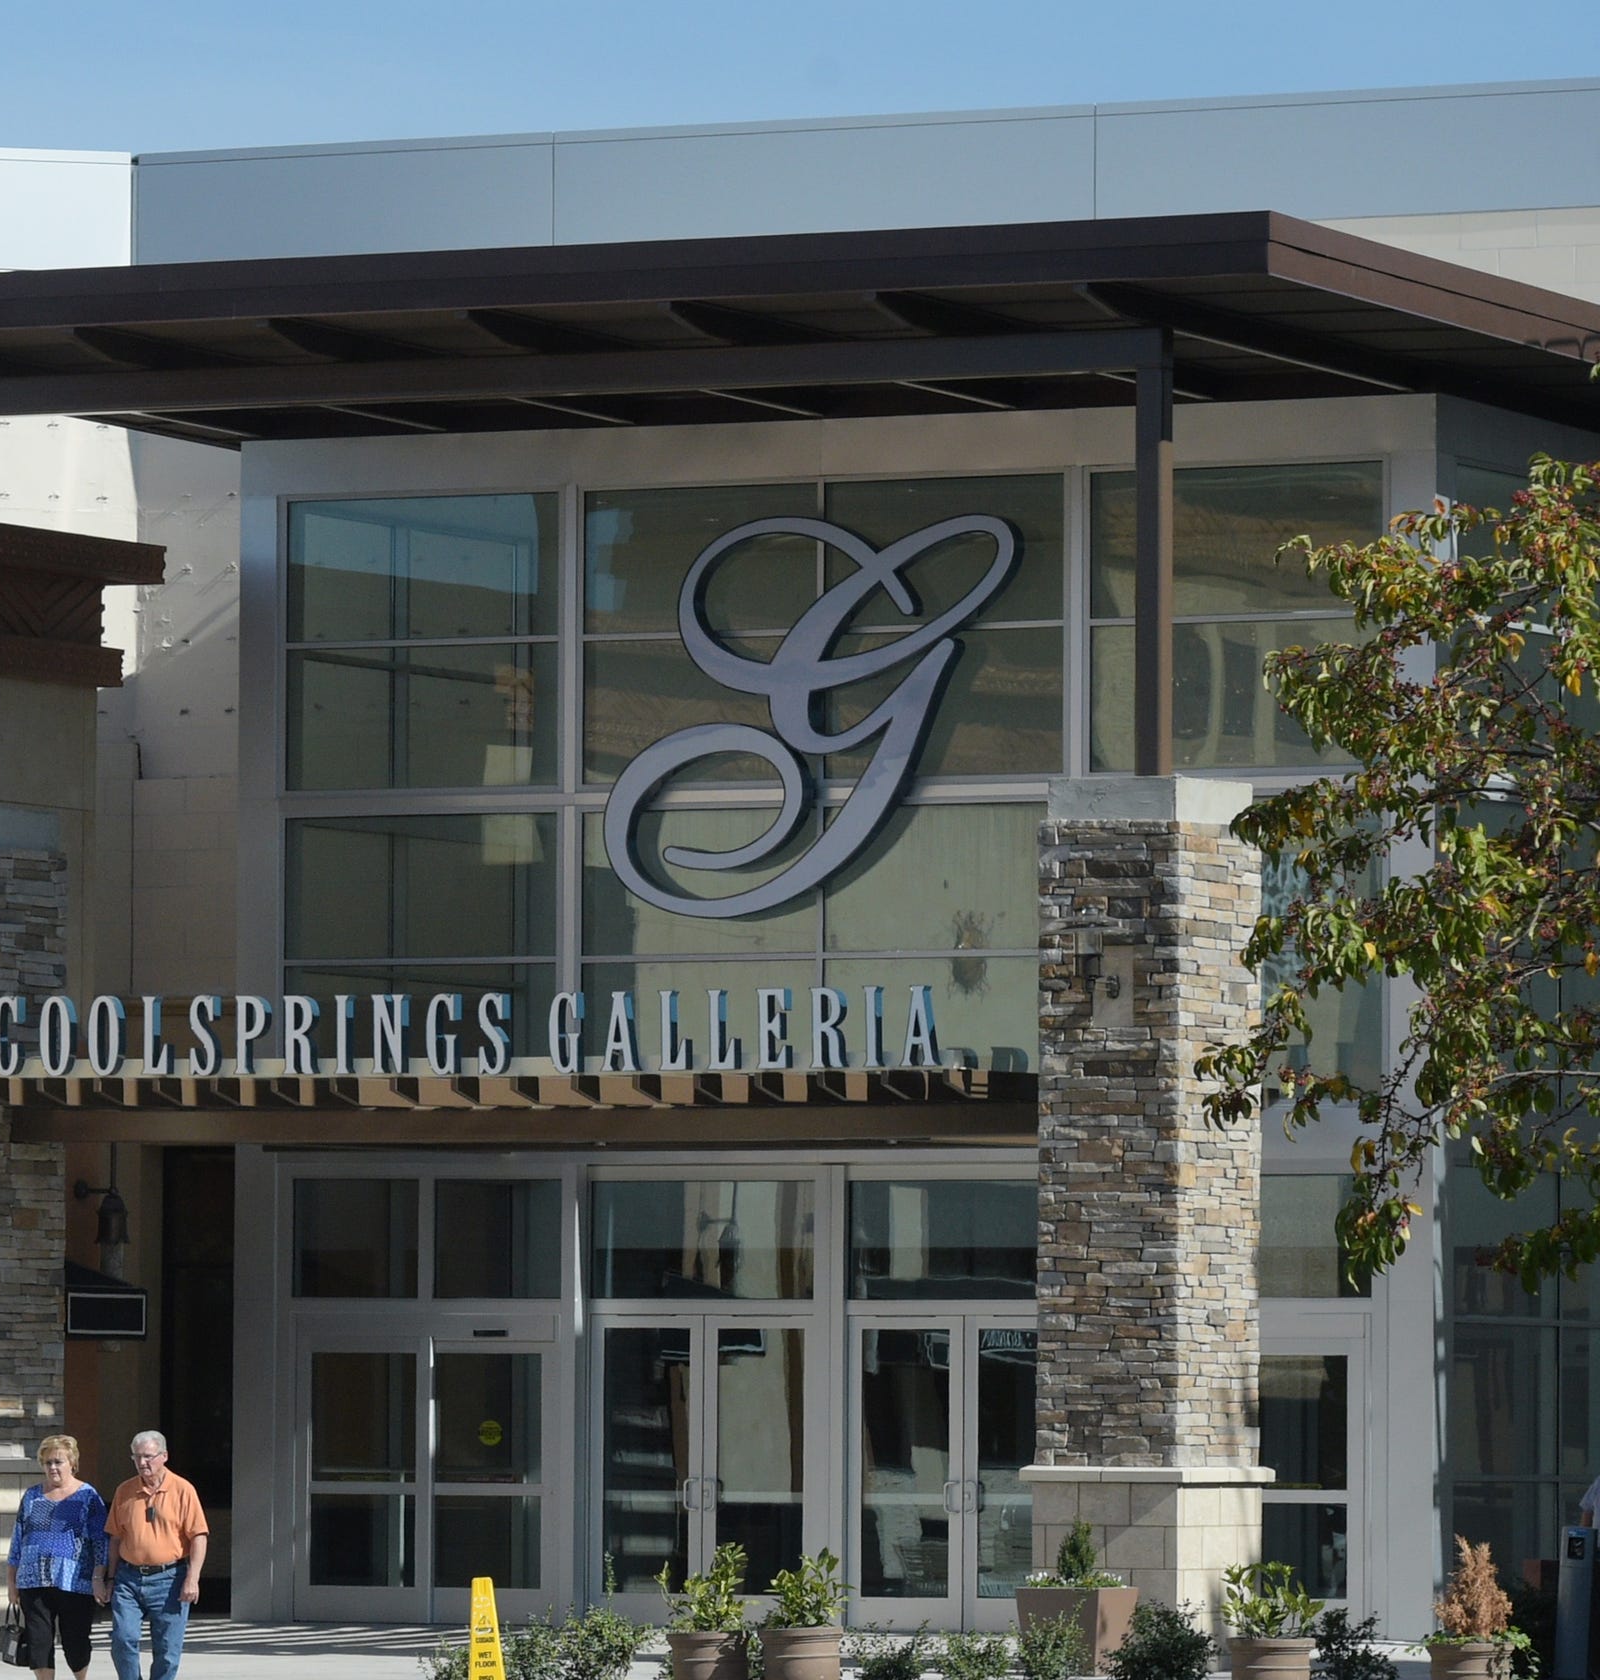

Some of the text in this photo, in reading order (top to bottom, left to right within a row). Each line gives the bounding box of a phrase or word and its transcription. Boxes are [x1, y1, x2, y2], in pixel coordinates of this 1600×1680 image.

[548, 985, 944, 1074] GALLERIA
[478, 1651, 492, 1659] WET
[475, 1660, 497, 1668] FLOOR
